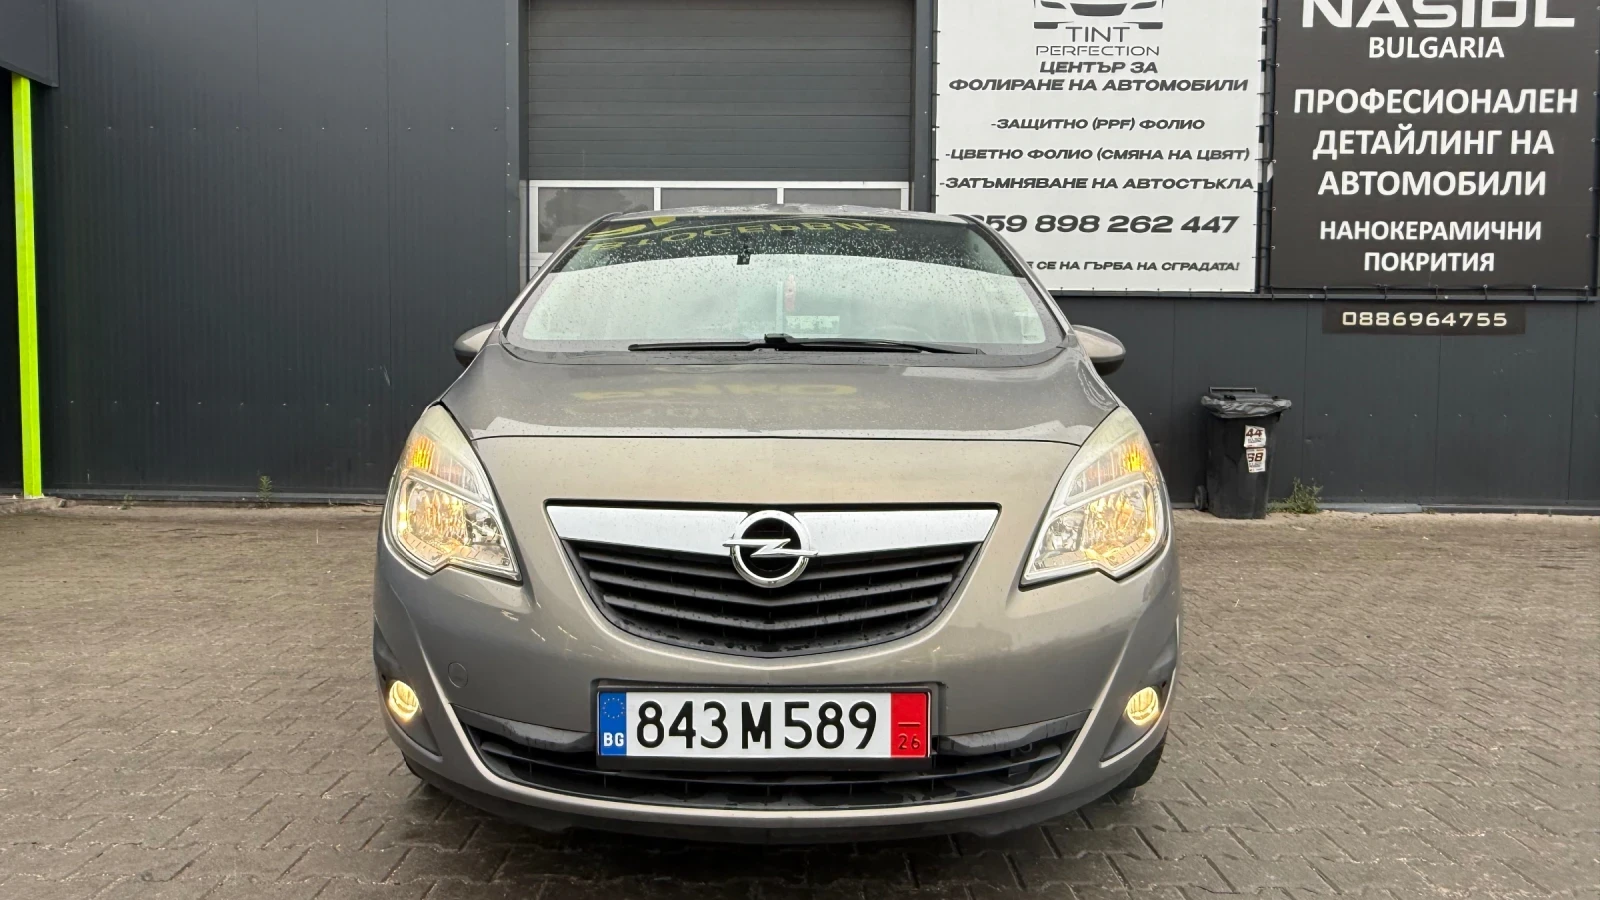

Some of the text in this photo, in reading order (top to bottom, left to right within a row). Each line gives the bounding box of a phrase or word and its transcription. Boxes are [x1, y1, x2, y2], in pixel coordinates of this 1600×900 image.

[1065, 27, 1130, 42] TINT
[1036, 46, 1160, 56] PERFECTION
[1369, 37, 1504, 58] BULGARIA
[1040, 62, 1158, 74] ЦЕНТЪР ЗА
[949, 79, 1248, 91] ФОЛИРАНЕ НА АВТОМОБИЛИ
[1294, 88, 1577, 113] ПРОФЕСИОНАЛЕН
[991, 117, 1205, 130] -ЗАЩИТНО (PPF) ФОЛИО
[1313, 124, 1554, 160] ДЕТАЙЛИНГ НА
[946, 148, 1249, 161] -ЦВЕТНО ФОЛИО (СМЯНА НА ЦВЯТ)
[940, 178, 1254, 190] -ЗАТЪМНЯВАНЕ НА АВТОСТЪКЛА
[1318, 171, 1546, 195] АВТОМОБИЛИ
[1035, 215, 1100, 233] 898
[1107, 216, 1173, 233] 262
[1181, 216, 1240, 233] 447
[1321, 221, 1541, 241] НАНОКЕРАМИЧНИ
[1037, 261, 1057, 270] СЕ
[1060, 261, 1080, 270] НА
[1084, 262, 1133, 270] ГЪРБА
[1137, 262, 1157, 270] НА
[1162, 262, 1240, 272] СГРАДАТА!
[1364, 252, 1494, 271] ПОКРИТИЯ
[1342, 311, 1508, 327] 0886964755
[1246, 429, 1262, 437] 44
[637, 701, 728, 749] 843
[785, 702, 877, 749] 589
[604, 733, 624, 747] BG
[898, 733, 921, 749] 26
